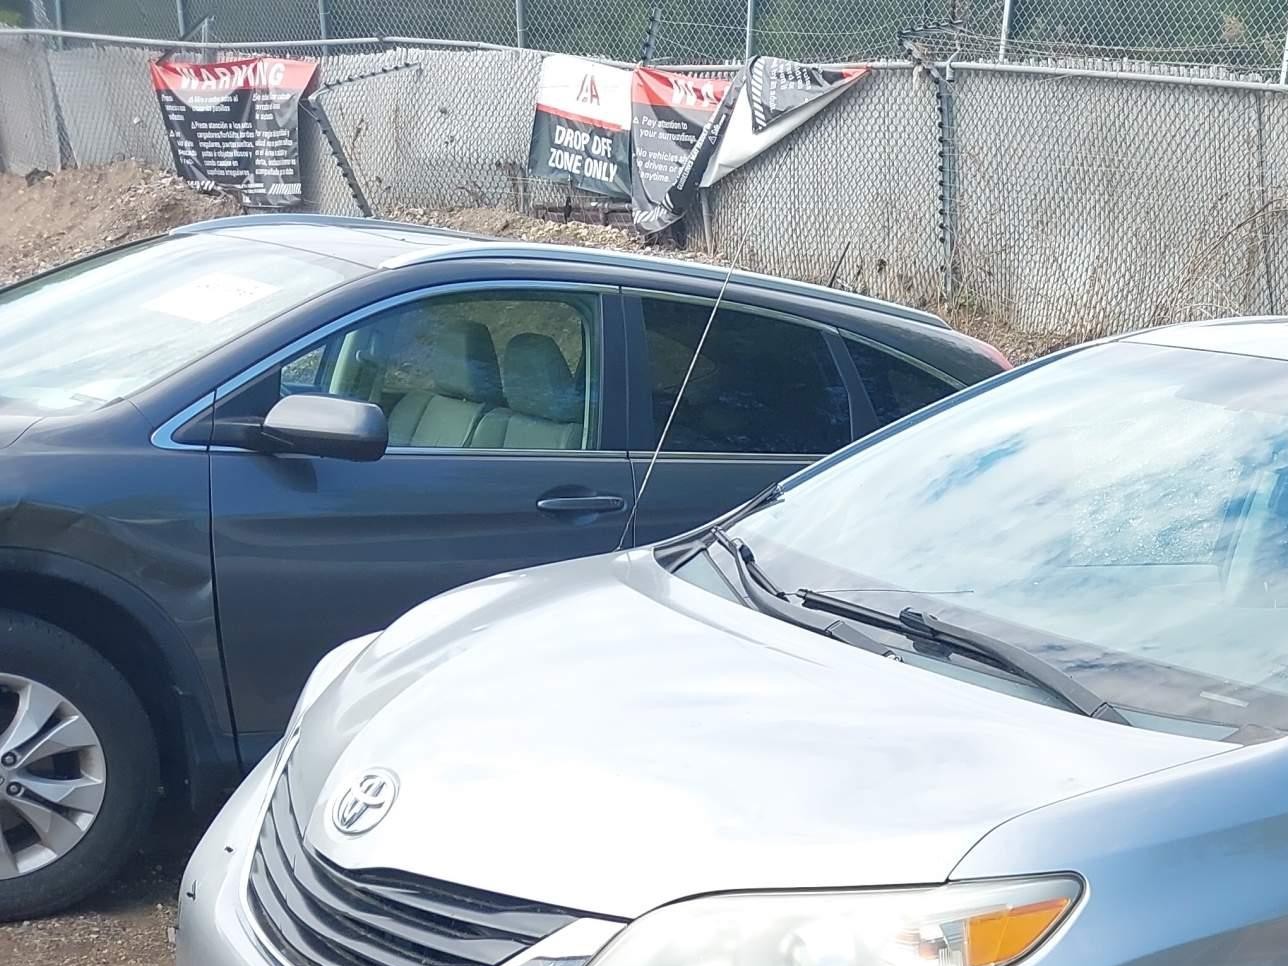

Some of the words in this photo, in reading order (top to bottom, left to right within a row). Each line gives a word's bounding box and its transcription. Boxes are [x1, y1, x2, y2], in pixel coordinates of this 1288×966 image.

[178, 60, 286, 90] WARNING
[641, 115, 657, 129] Pay
[657, 119, 681, 131] attention
[553, 125, 590, 152] DROP
[591, 135, 613, 158] OFF
[639, 128, 657, 142] your
[636, 146, 648, 158] No
[648, 150, 677, 164] vehicles
[548, 147, 582, 175] ZONE
[584, 157, 618, 183] ONLY
[644, 159, 669, 174] driven
[669, 164, 678, 174] or
